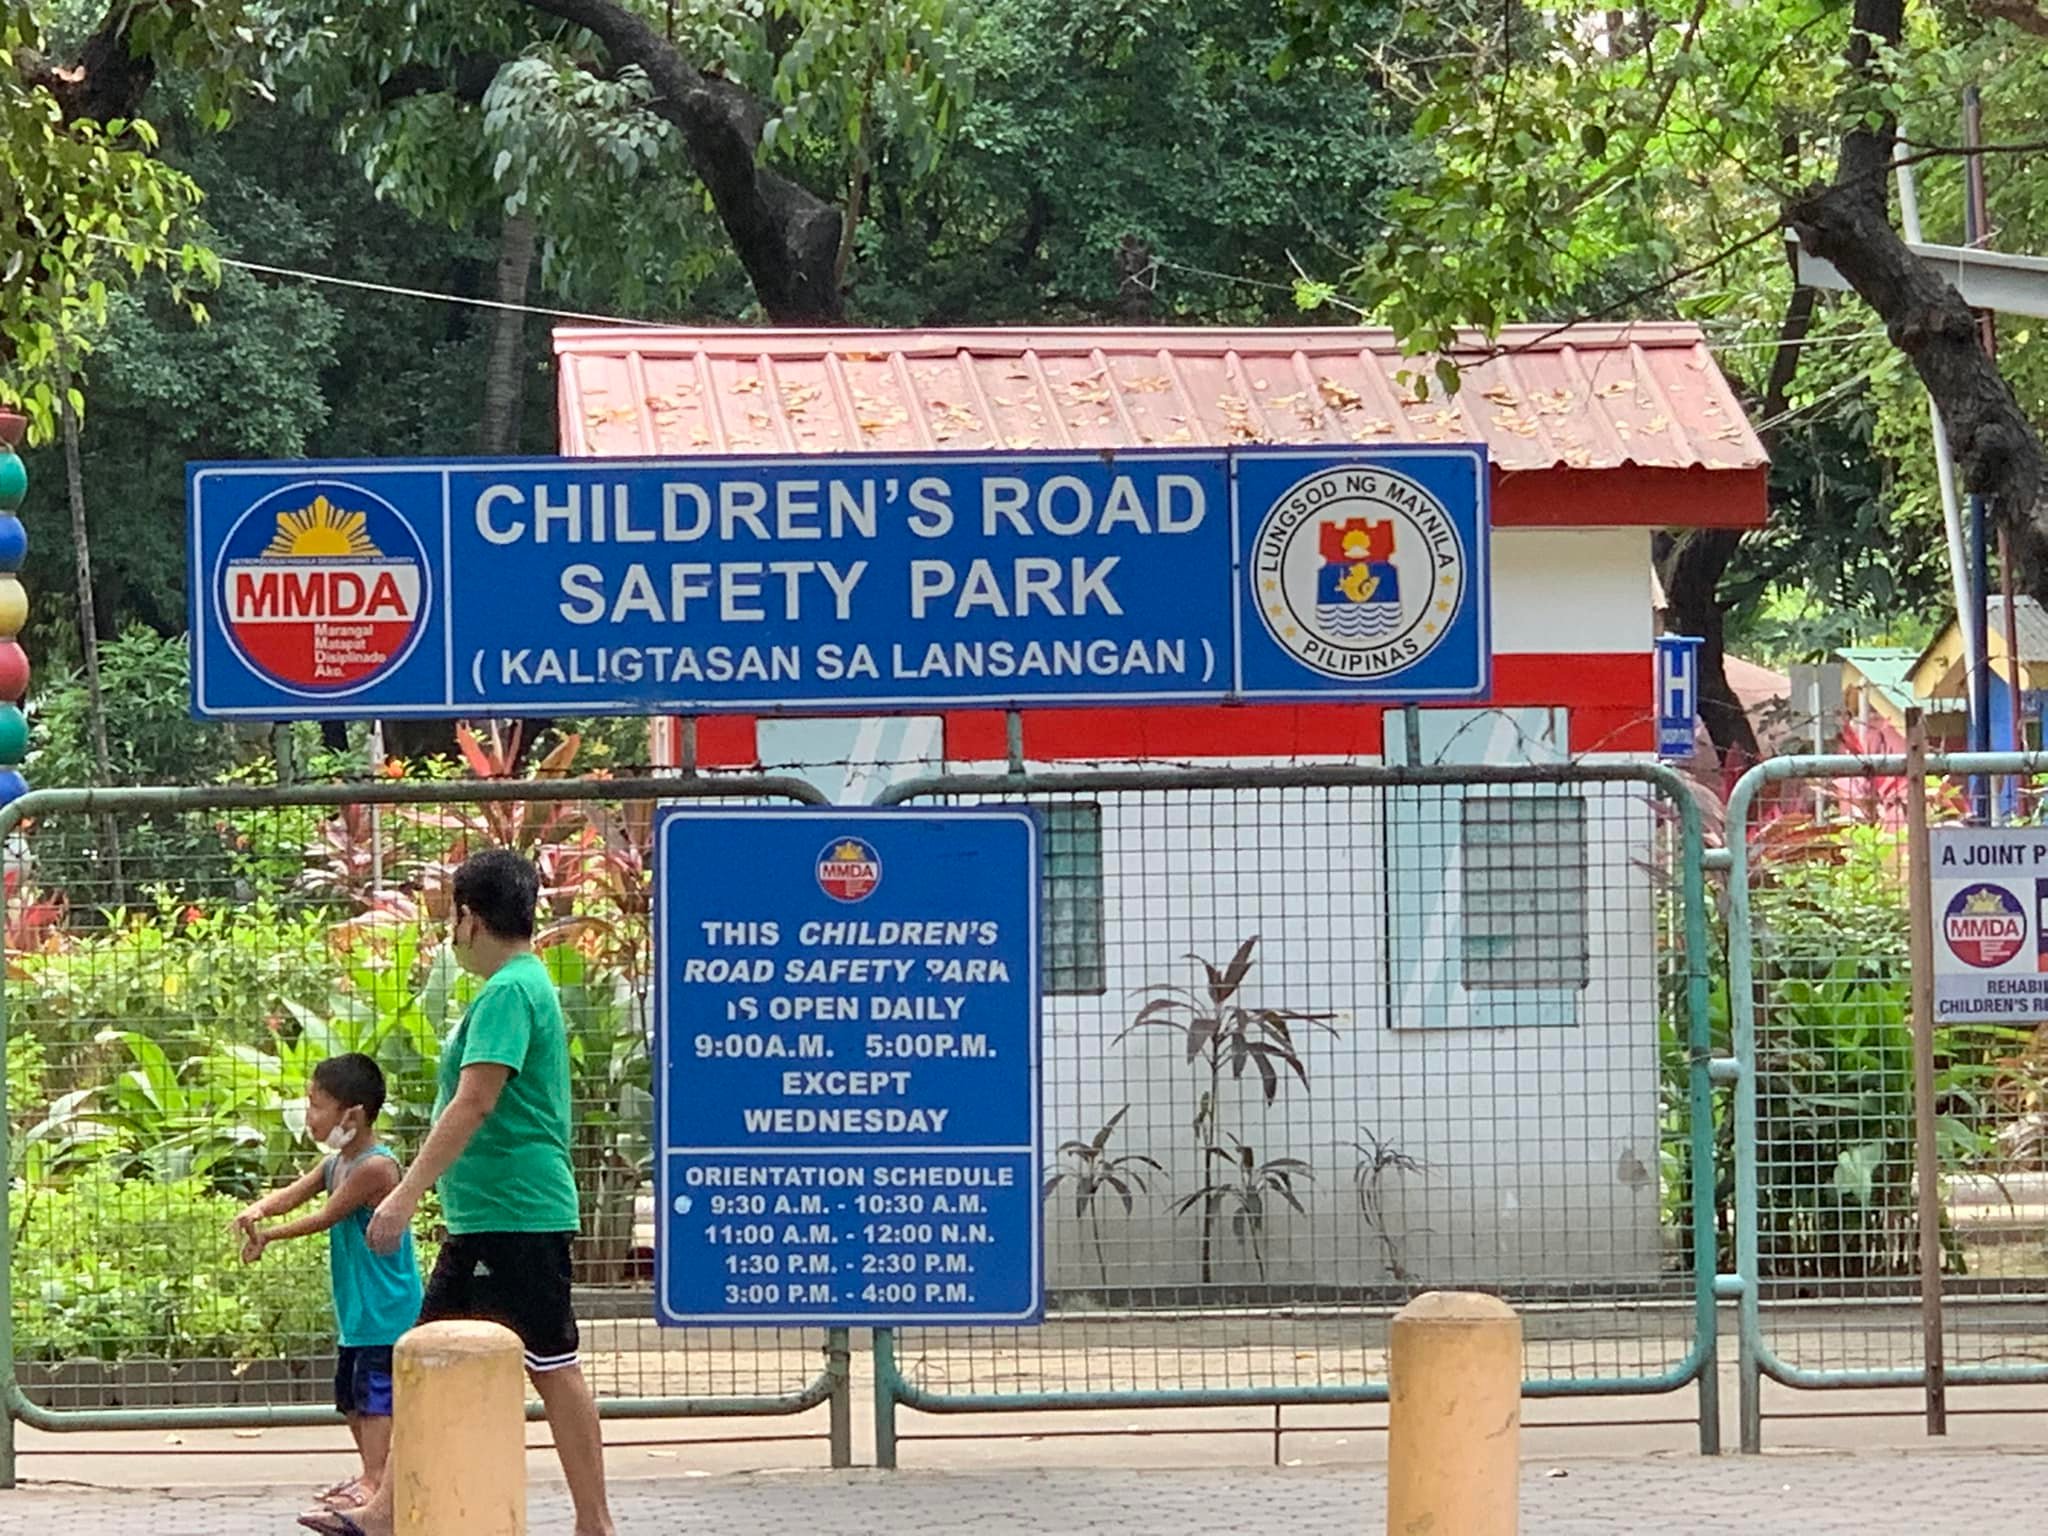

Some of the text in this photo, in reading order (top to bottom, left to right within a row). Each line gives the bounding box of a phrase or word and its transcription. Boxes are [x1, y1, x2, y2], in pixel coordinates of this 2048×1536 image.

[474, 475, 1206, 545] CHILDREN'S ROAD
[1261, 475, 1455, 573] LUNGSOD NG MAYNILA
[236, 571, 408, 617] MMDA
[559, 555, 1123, 624] SAFETY PARK
[501, 646, 801, 684] KALIGTASAN
[816, 644, 880, 681] SA
[892, 638, 1187, 680] LANSANGAN
[1303, 637, 1418, 671] PILIPINAS
[1664, 650, 1691, 719] H
[1942, 846, 1956, 866] A
[1964, 845, 2026, 866] JOINT
[823, 864, 874, 878] MMDA
[702, 921, 999, 946] THIS CHILDREN'S
[1951, 918, 2020, 938] MMDA
[683, 958, 1010, 984] ROAD SAFETY PARK
[727, 996, 966, 1021] IS OPEN DAILY
[1939, 998, 2029, 1015] CHILDREN'S
[695, 1034, 997, 1059] 9:00A.M. 5:00P.M.
[782, 1071, 912, 1096] EXCEPT
[743, 1108, 949, 1134] WEDNESDAY
[685, 1166, 1014, 1187] ORIENTATION SCHEDULE
[710, 1195, 766, 1215] 9:30
[774, 1195, 829, 1215] A.M.
[854, 1194, 924, 1214] 10:30
[932, 1194, 988, 1214] A.M.
[704, 1225, 774, 1244] 11:00
[782, 1224, 838, 1244] A.M.
[863, 1224, 932, 1243] 12:00
[940, 1224, 995, 1243] N.N.
[725, 1254, 780, 1274] 1:30
[788, 1254, 838, 1274] P.M.
[861, 1254, 917, 1273] 2:30
[924, 1253, 975, 1273] P.M.
[725, 1284, 780, 1304] 3:00
[788, 1284, 838, 1303] P.M.
[861, 1283, 917, 1303] 4:00
[924, 1283, 975, 1303] P.M.
